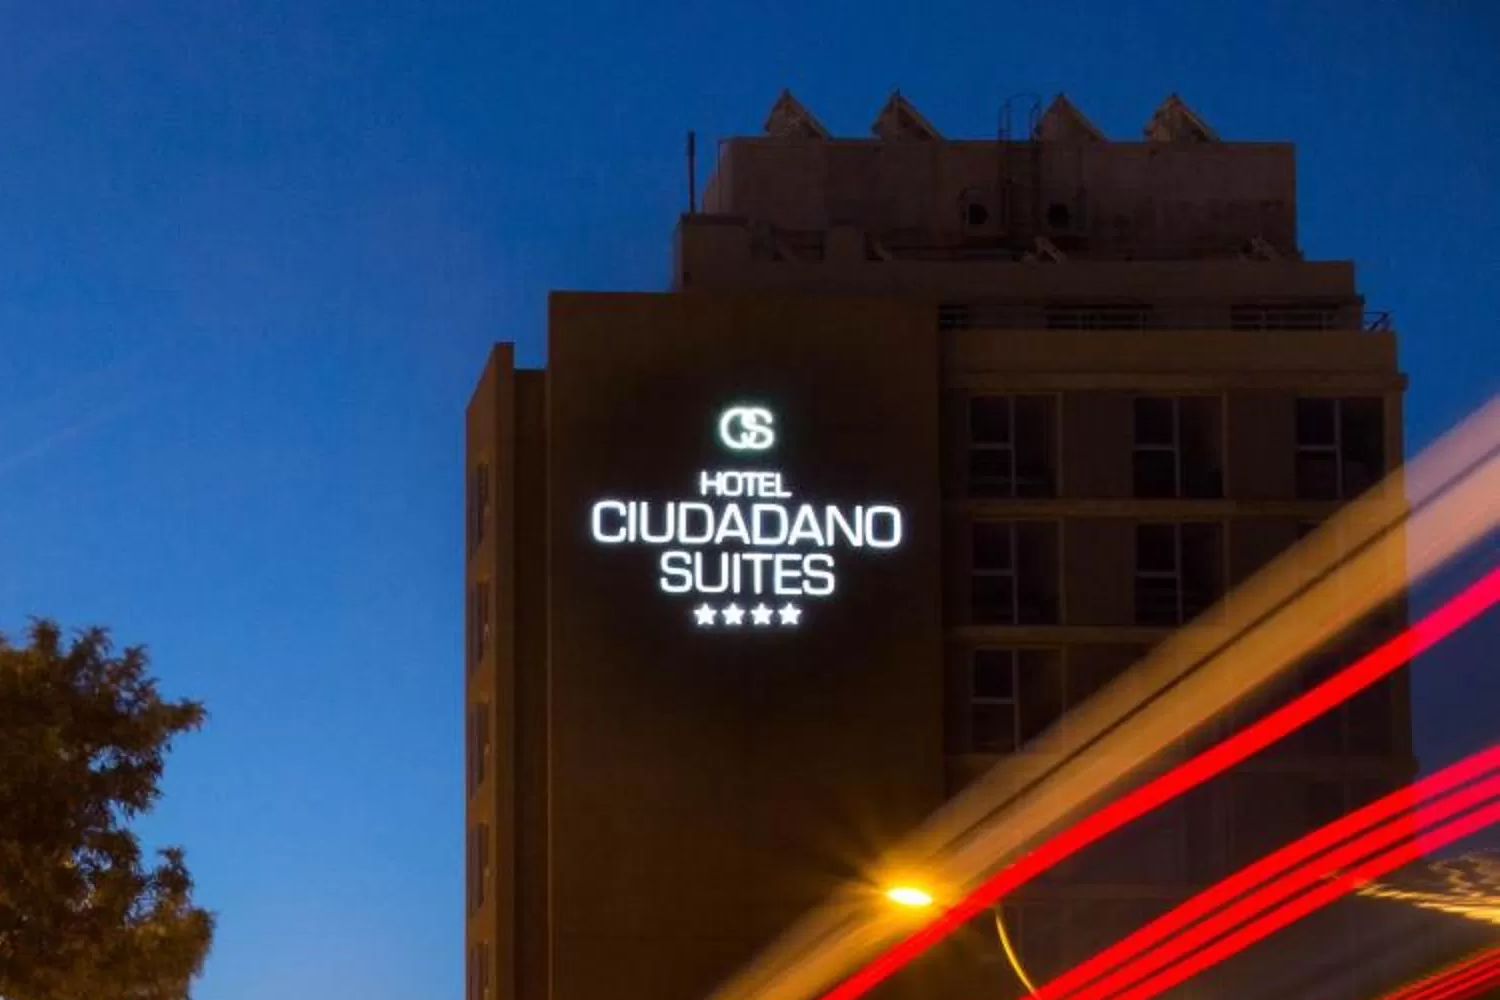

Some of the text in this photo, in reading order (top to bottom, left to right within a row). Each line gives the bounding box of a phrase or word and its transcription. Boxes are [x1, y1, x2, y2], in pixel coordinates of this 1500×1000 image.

[701, 470, 792, 498] HOTEL
[592, 500, 902, 549] CIUDADANO
[659, 551, 836, 596] SUITES
